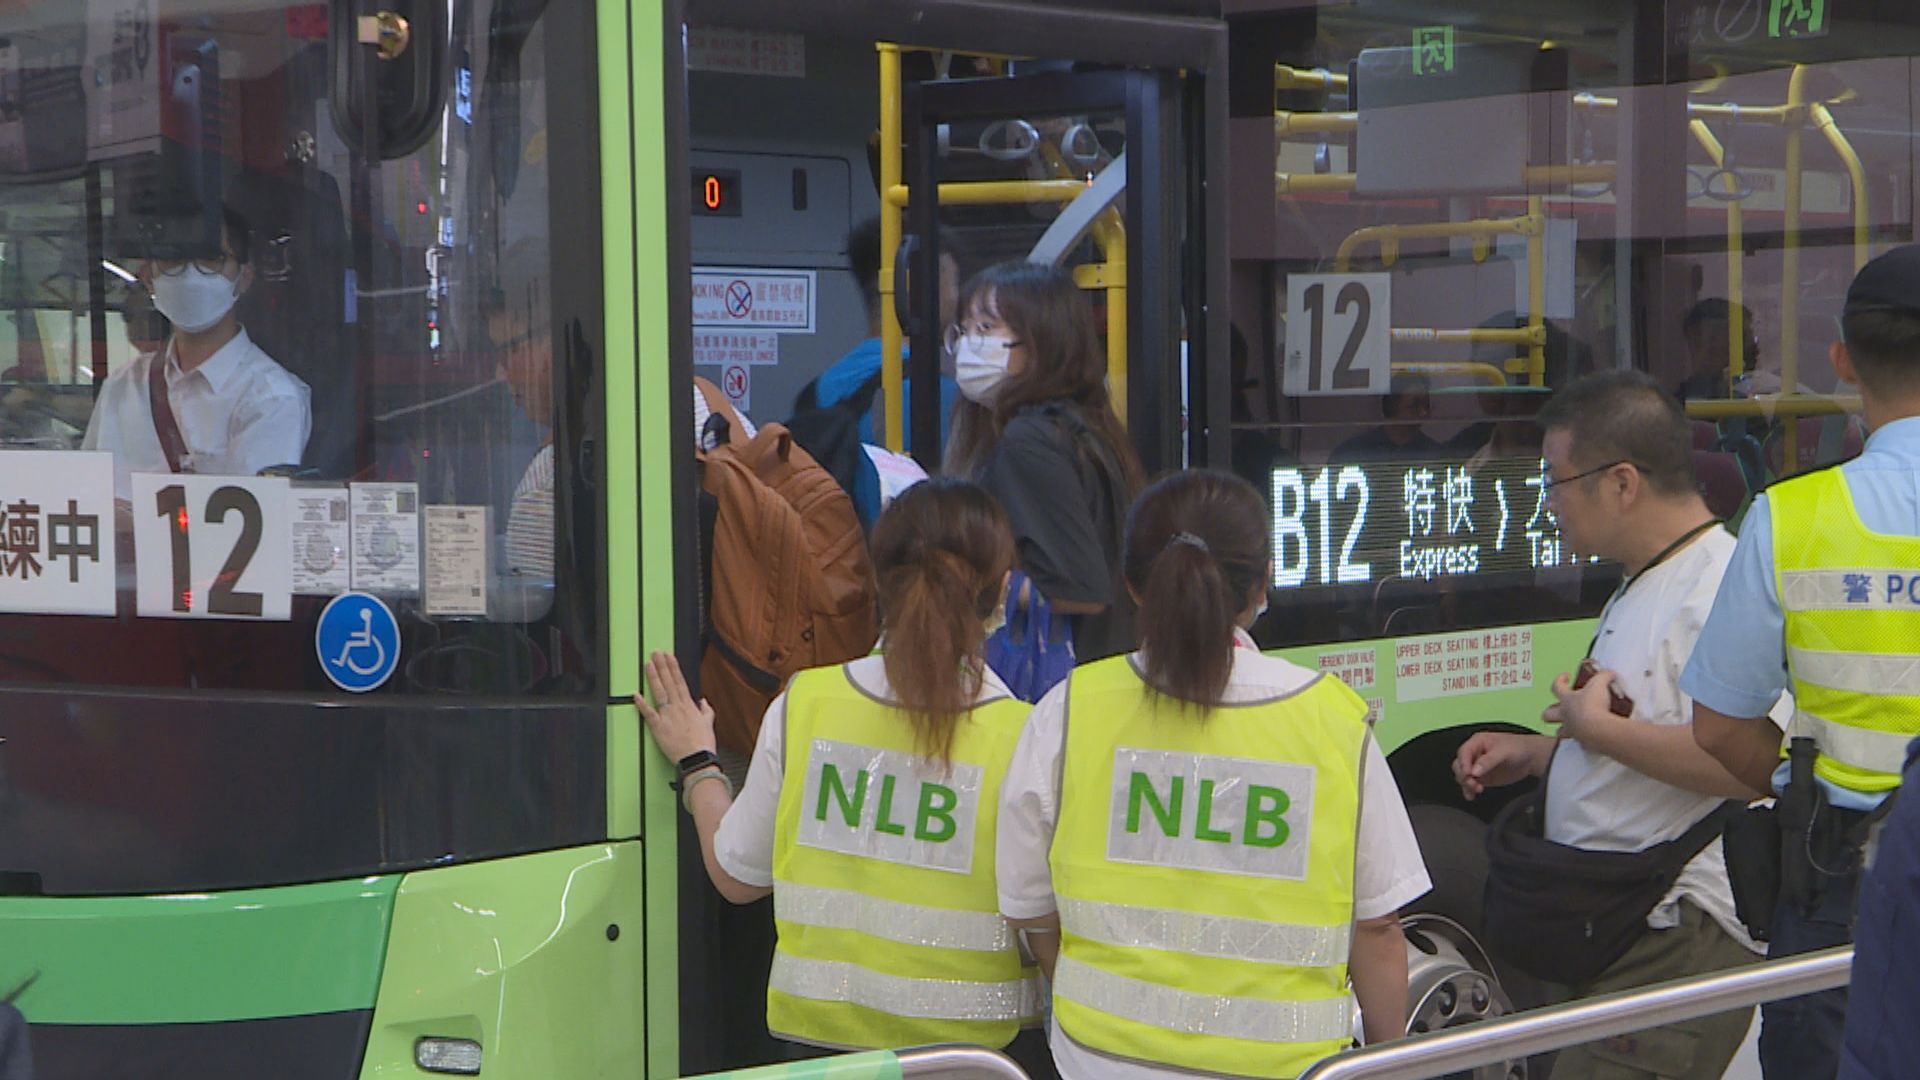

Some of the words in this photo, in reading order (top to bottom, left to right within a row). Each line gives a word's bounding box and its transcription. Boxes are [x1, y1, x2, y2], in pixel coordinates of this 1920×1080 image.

[704, 175, 720, 208] 0
[707, 350, 726, 361] STOP
[729, 350, 753, 361] PRESS
[1303, 281, 1371, 391] 12
[1272, 465, 1370, 588] B12
[1403, 465, 1475, 536] 特快
[155, 484, 264, 617] 12
[1400, 539, 1479, 582] Express
[1525, 530, 1560, 568] Tai
[1842, 573, 1873, 603] 警
[1396, 643, 1420, 658] UPPER
[1424, 641, 1442, 656] DECK
[1447, 637, 1478, 653] SEATING
[1483, 632, 1517, 650] 樓上座位
[1396, 662, 1420, 677] LOWER
[1424, 660, 1443, 675] DECK
[1447, 656, 1478, 671] SEATING
[1483, 651, 1517, 669] 樓下座位
[1521, 650, 1531, 663] 27
[1442, 674, 1478, 691] STANDING
[815, 763, 958, 844] NLB
[1124, 771, 1291, 849] NLB
